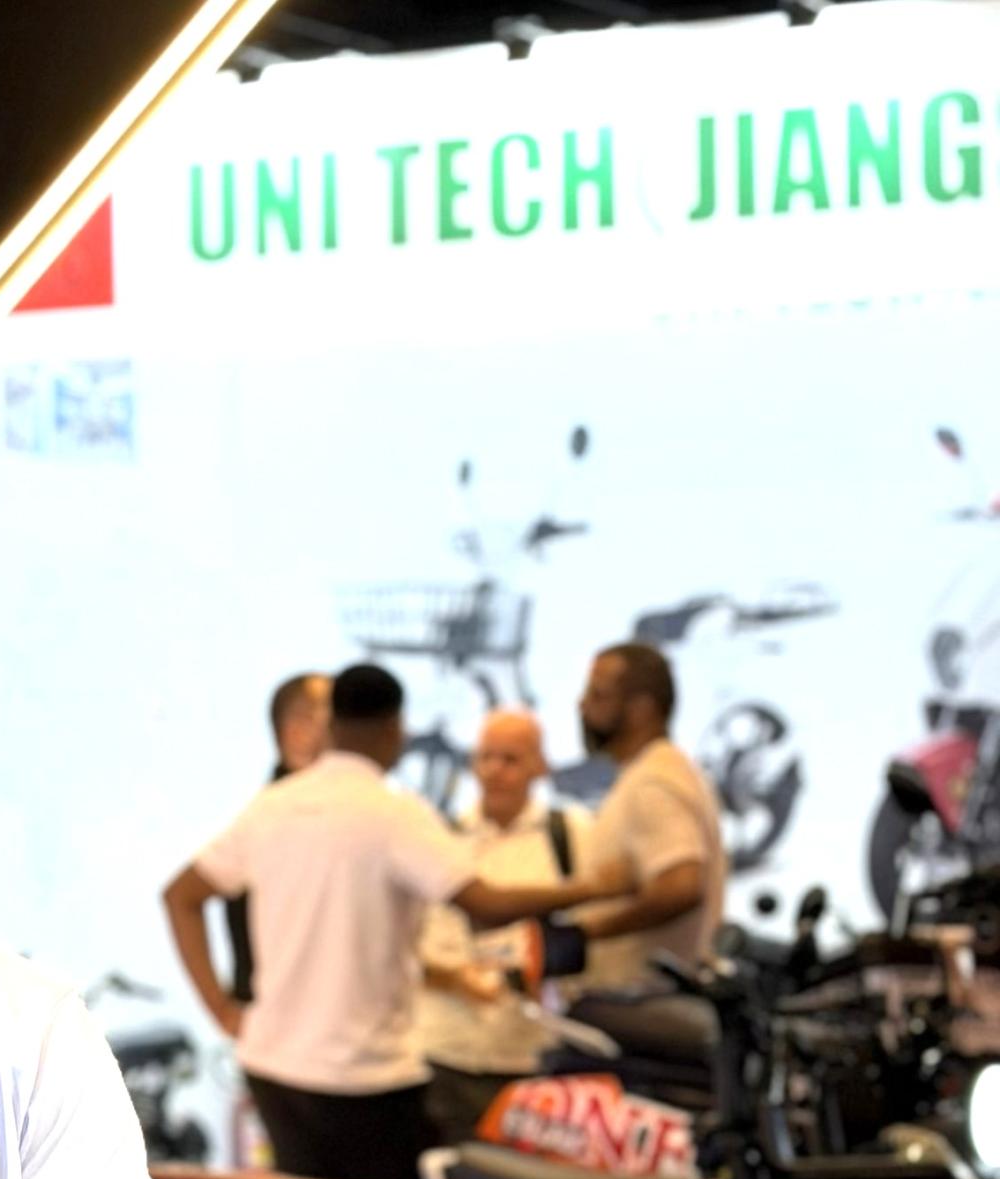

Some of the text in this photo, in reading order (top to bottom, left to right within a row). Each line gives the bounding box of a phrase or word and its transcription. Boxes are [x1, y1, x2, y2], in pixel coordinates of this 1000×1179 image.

[190, 90, 1000, 262] UNI TECH JIANG
